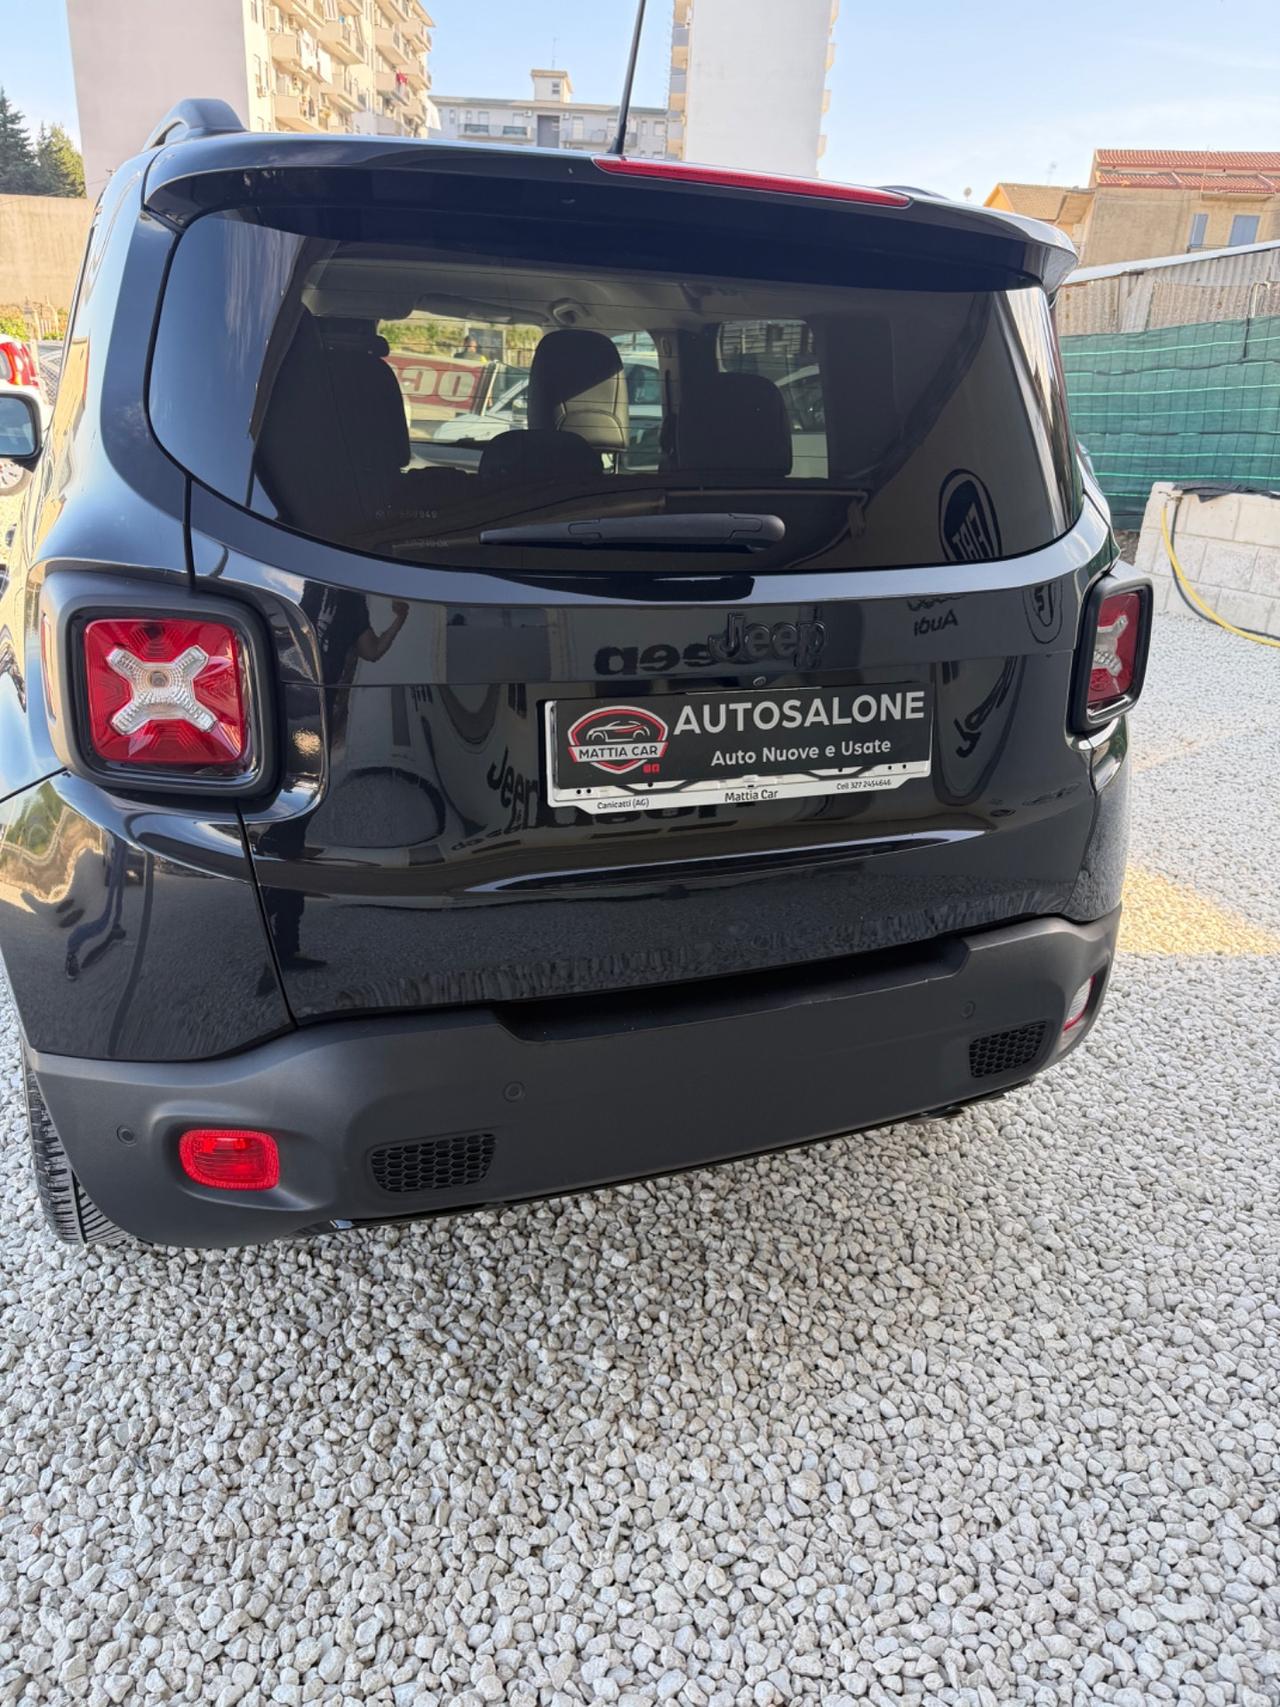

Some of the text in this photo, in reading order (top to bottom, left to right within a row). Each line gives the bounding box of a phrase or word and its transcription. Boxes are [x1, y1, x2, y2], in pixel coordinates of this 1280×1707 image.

[707, 611, 825, 669] Jeep
[673, 691, 925, 735] AUTOSALONE
[578, 744, 659, 759] MATTIA CAR
[710, 739, 892, 767] Auto Nuove e Usate
[836, 781, 850, 790] Cell
[850, 780, 862, 789] 327
[724, 788, 778, 802] Mattia Car
[597, 798, 650, 810] Canicatti (AG)
